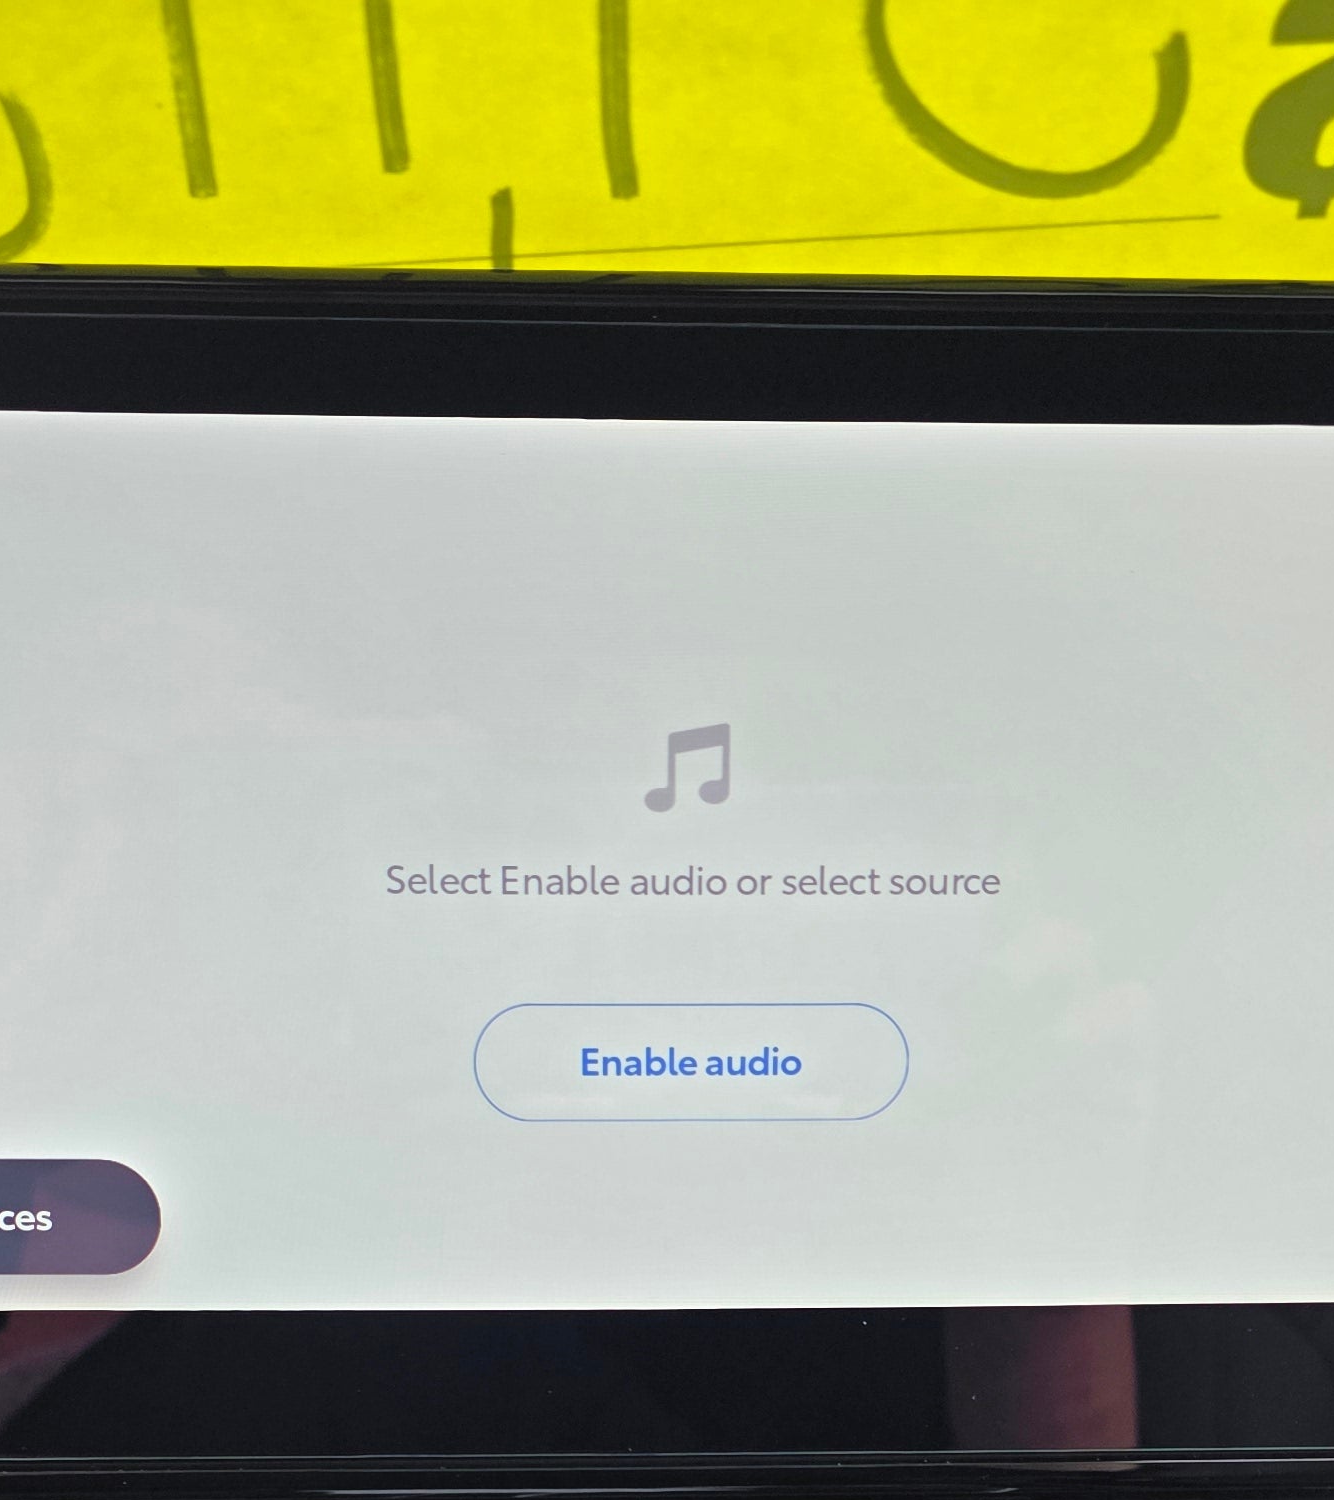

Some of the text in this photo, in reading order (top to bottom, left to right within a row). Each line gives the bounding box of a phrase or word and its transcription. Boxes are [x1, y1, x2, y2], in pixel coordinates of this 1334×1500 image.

[385, 865, 1001, 896] Select Enable audio or select source
[580, 1047, 802, 1077] Enable audio
